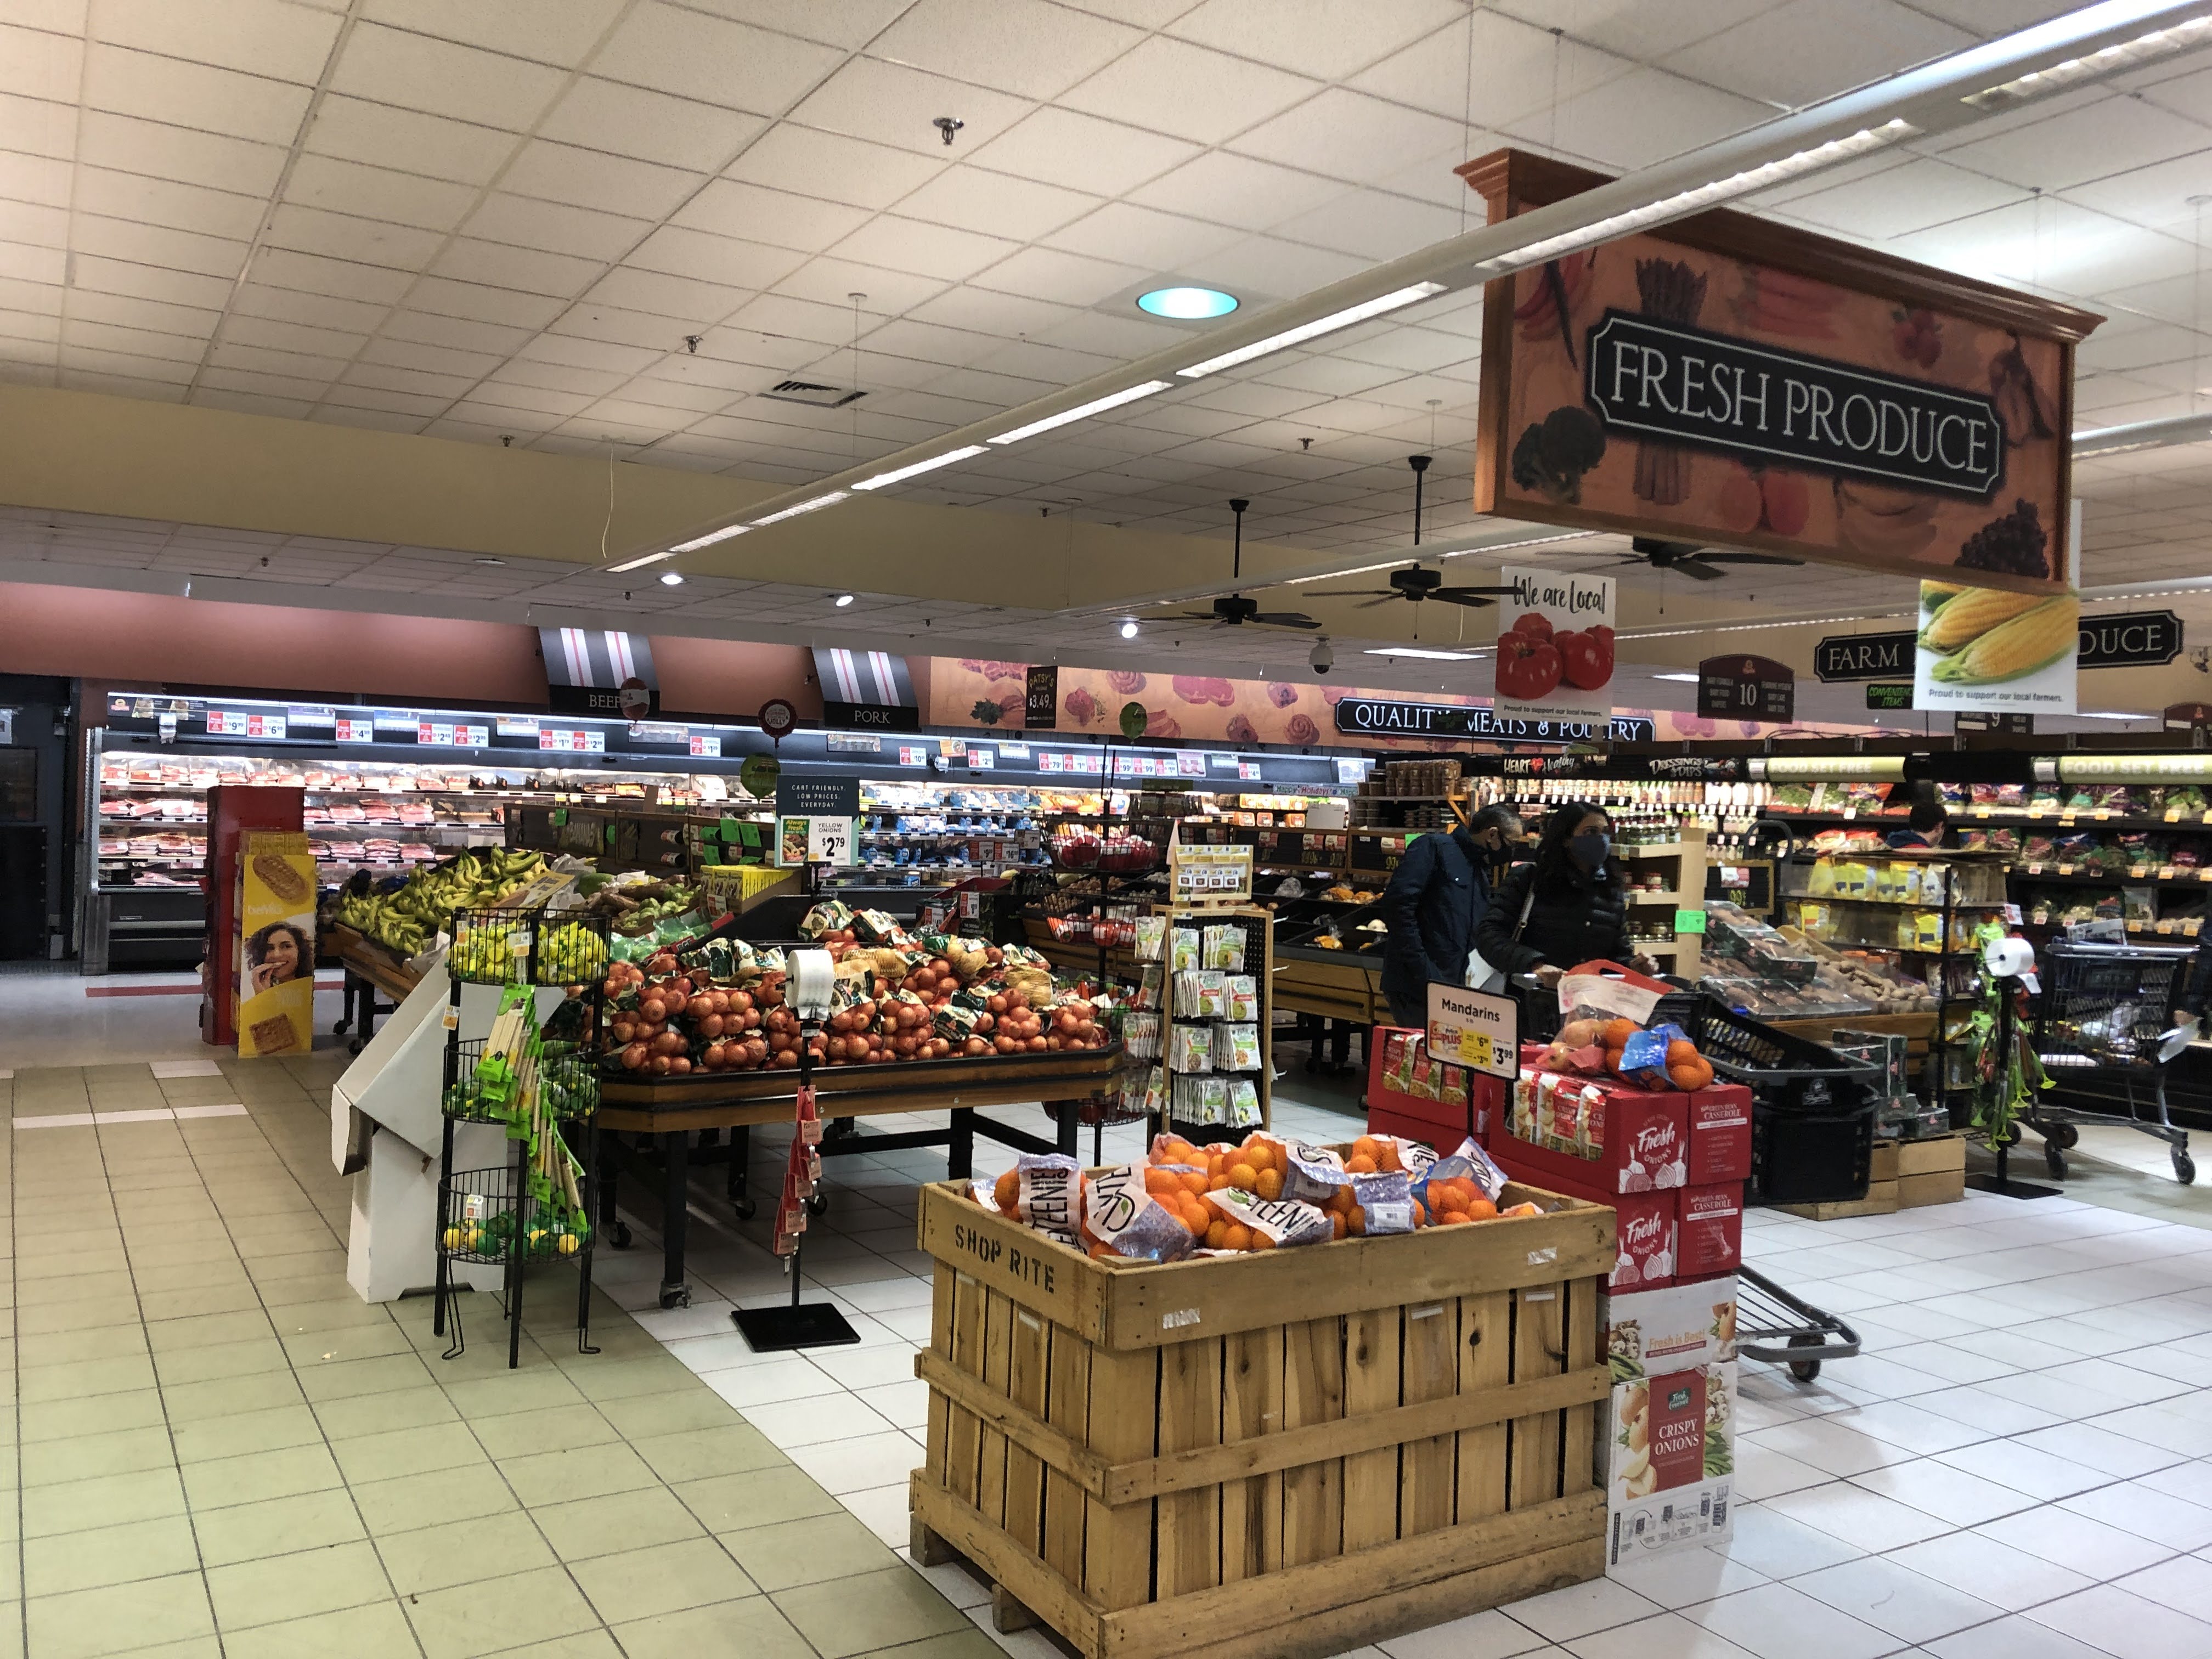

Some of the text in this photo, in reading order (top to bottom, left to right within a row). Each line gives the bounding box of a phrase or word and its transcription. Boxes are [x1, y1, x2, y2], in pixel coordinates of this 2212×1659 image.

[1611, 340, 1988, 475] FRESH PRODUCE
[1513, 575, 1606, 614] We are Local
[1828, 624, 2163, 671] FARM DUCE
[1740, 684, 1757, 706] 10
[1869, 686, 1914, 698] CONVENIENC
[1929, 689, 1954, 698] Proud
[1955, 690, 1964, 698] to
[1966, 691, 1997, 701] support
[2013, 692, 2030, 701] local
[2032, 693, 2064, 703] farmers.
[589, 694, 620, 709] BEEF
[1029, 694, 1050, 709] $3.49
[1881, 697, 1904, 707] ITEMS
[854, 710, 890, 724] PORK
[1504, 704, 1522, 713] Proud
[1531, 707, 1554, 716] support
[1356, 704, 1450, 730] QUALIT
[1559, 720, 1641, 741] POUTRY
[1991, 712, 2001, 727] 9
[1504, 758, 1531, 774] HEART
[2064, 760, 2204, 775] FOOD SET FREE
[1276, 785, 1296, 794] Happy
[1340, 787, 1357, 797] Happ
[1442, 998, 1500, 1022] Mandarins
[1442, 1034, 1462, 1045] PLUS
[1704, 1109, 1741, 1120] CASSEROLE
[1637, 1121, 1675, 1153] Fresh
[1644, 1148, 1672, 1165] ONIONS
[1694, 1199, 1732, 1211] CASSEROLE
[1626, 1211, 1662, 1244] Fresh
[1632, 1238, 1658, 1255] ONIONS
[954, 1223, 1054, 1294] SHOP RITE
[1649, 1334, 1673, 1350] Fresh
[1675, 1334, 1682, 1344] is
[1658, 1418, 1698, 1439] CRISPY
[1655, 1434, 1699, 1456] ONIONS
